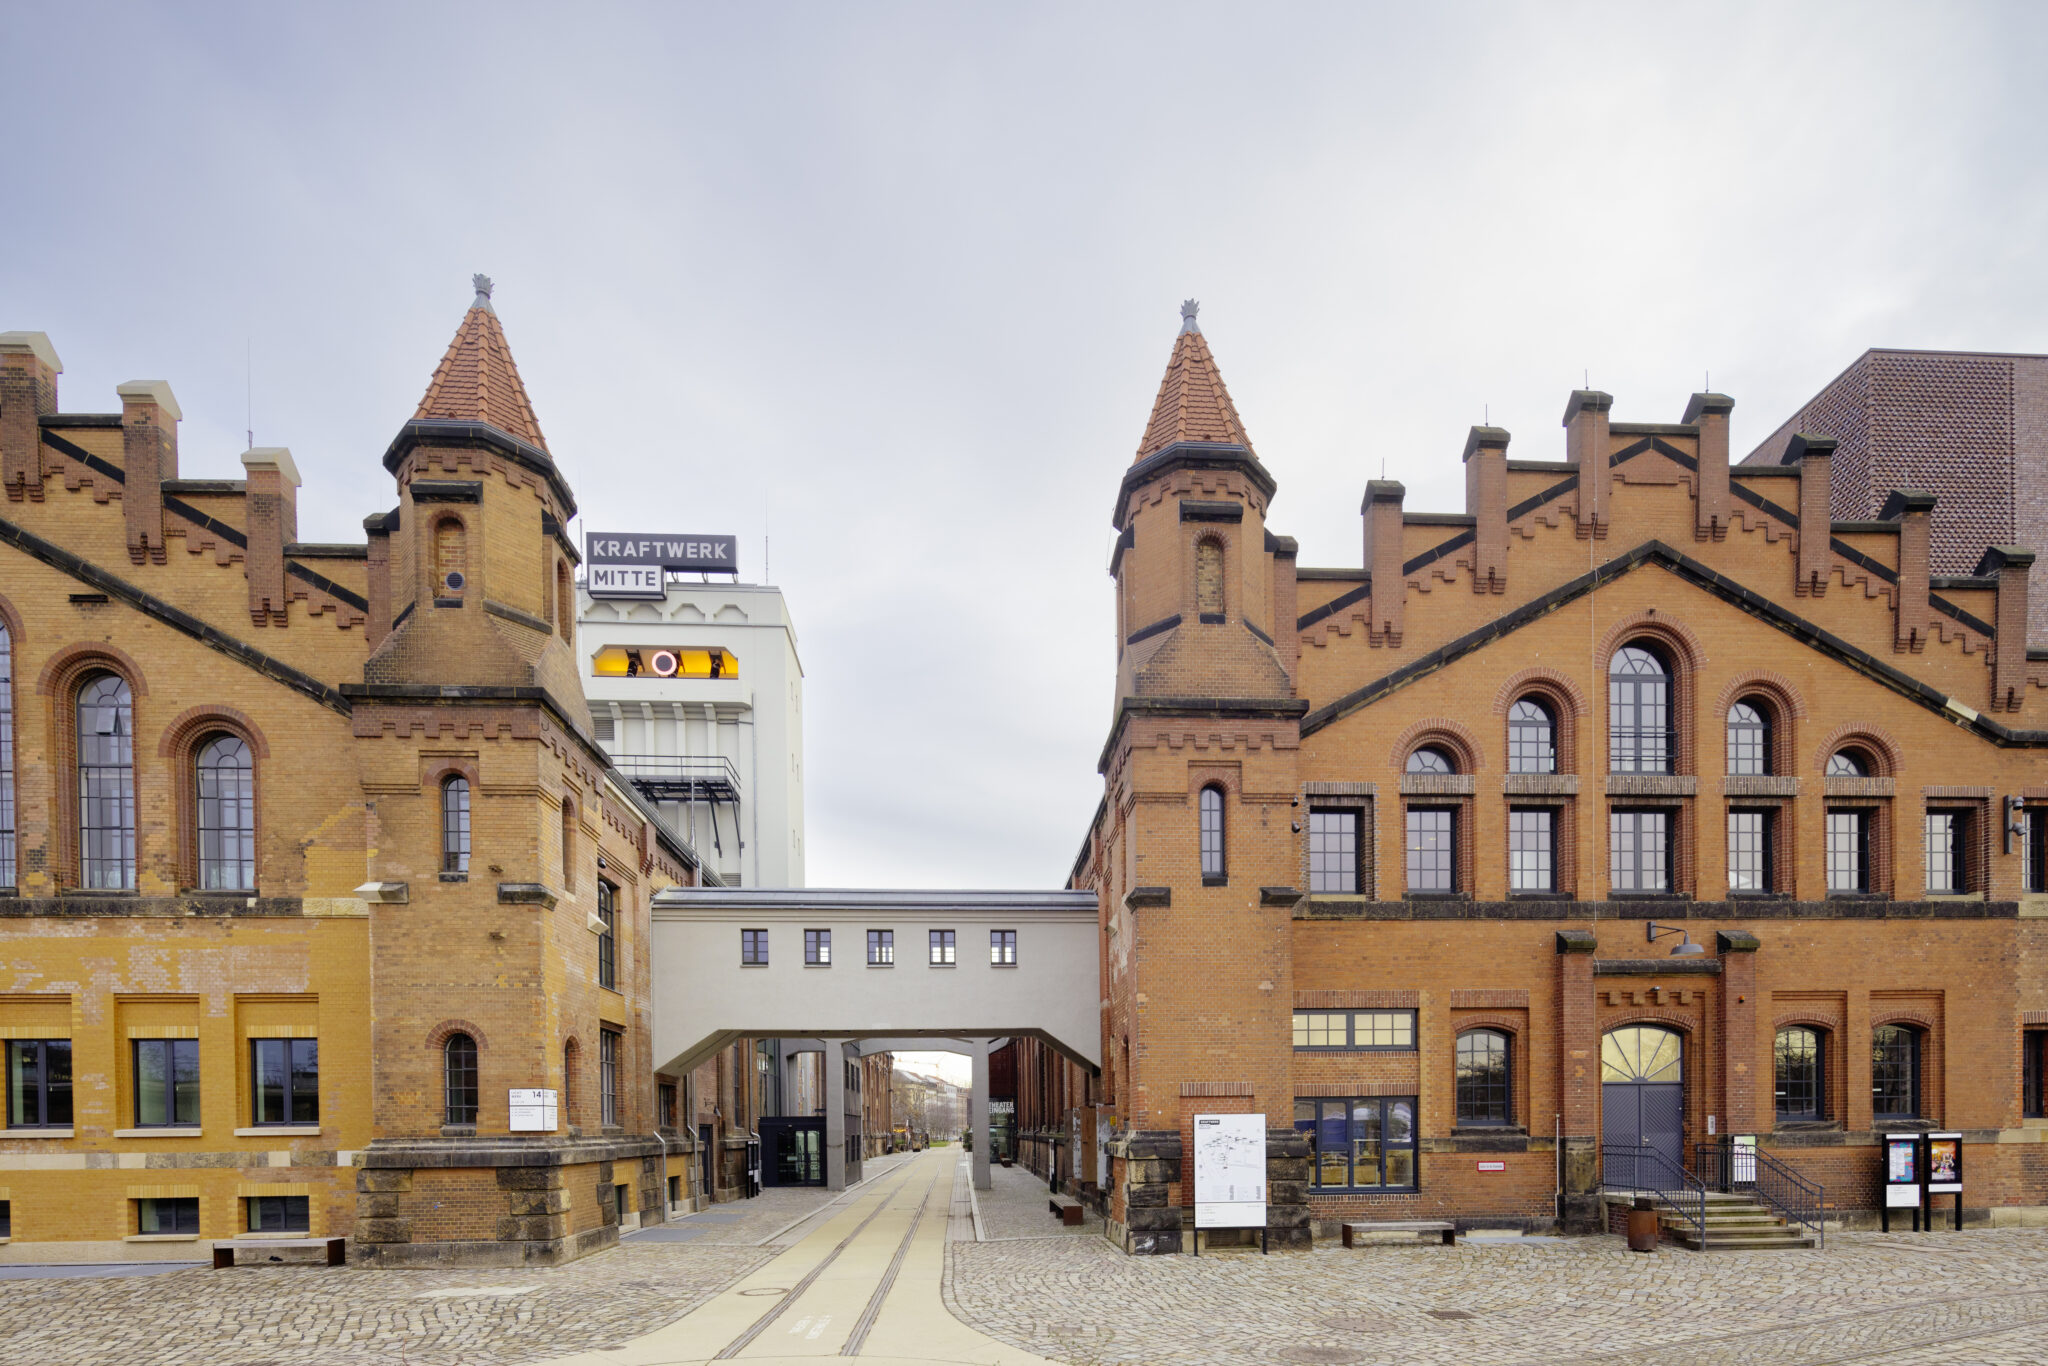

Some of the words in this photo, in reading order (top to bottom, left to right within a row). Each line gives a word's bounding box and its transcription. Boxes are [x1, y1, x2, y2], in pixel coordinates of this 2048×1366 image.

[593, 540, 727, 559] KRAFTWERK
[594, 570, 656, 586] MITTE
[532, 1090, 541, 1098] 14
